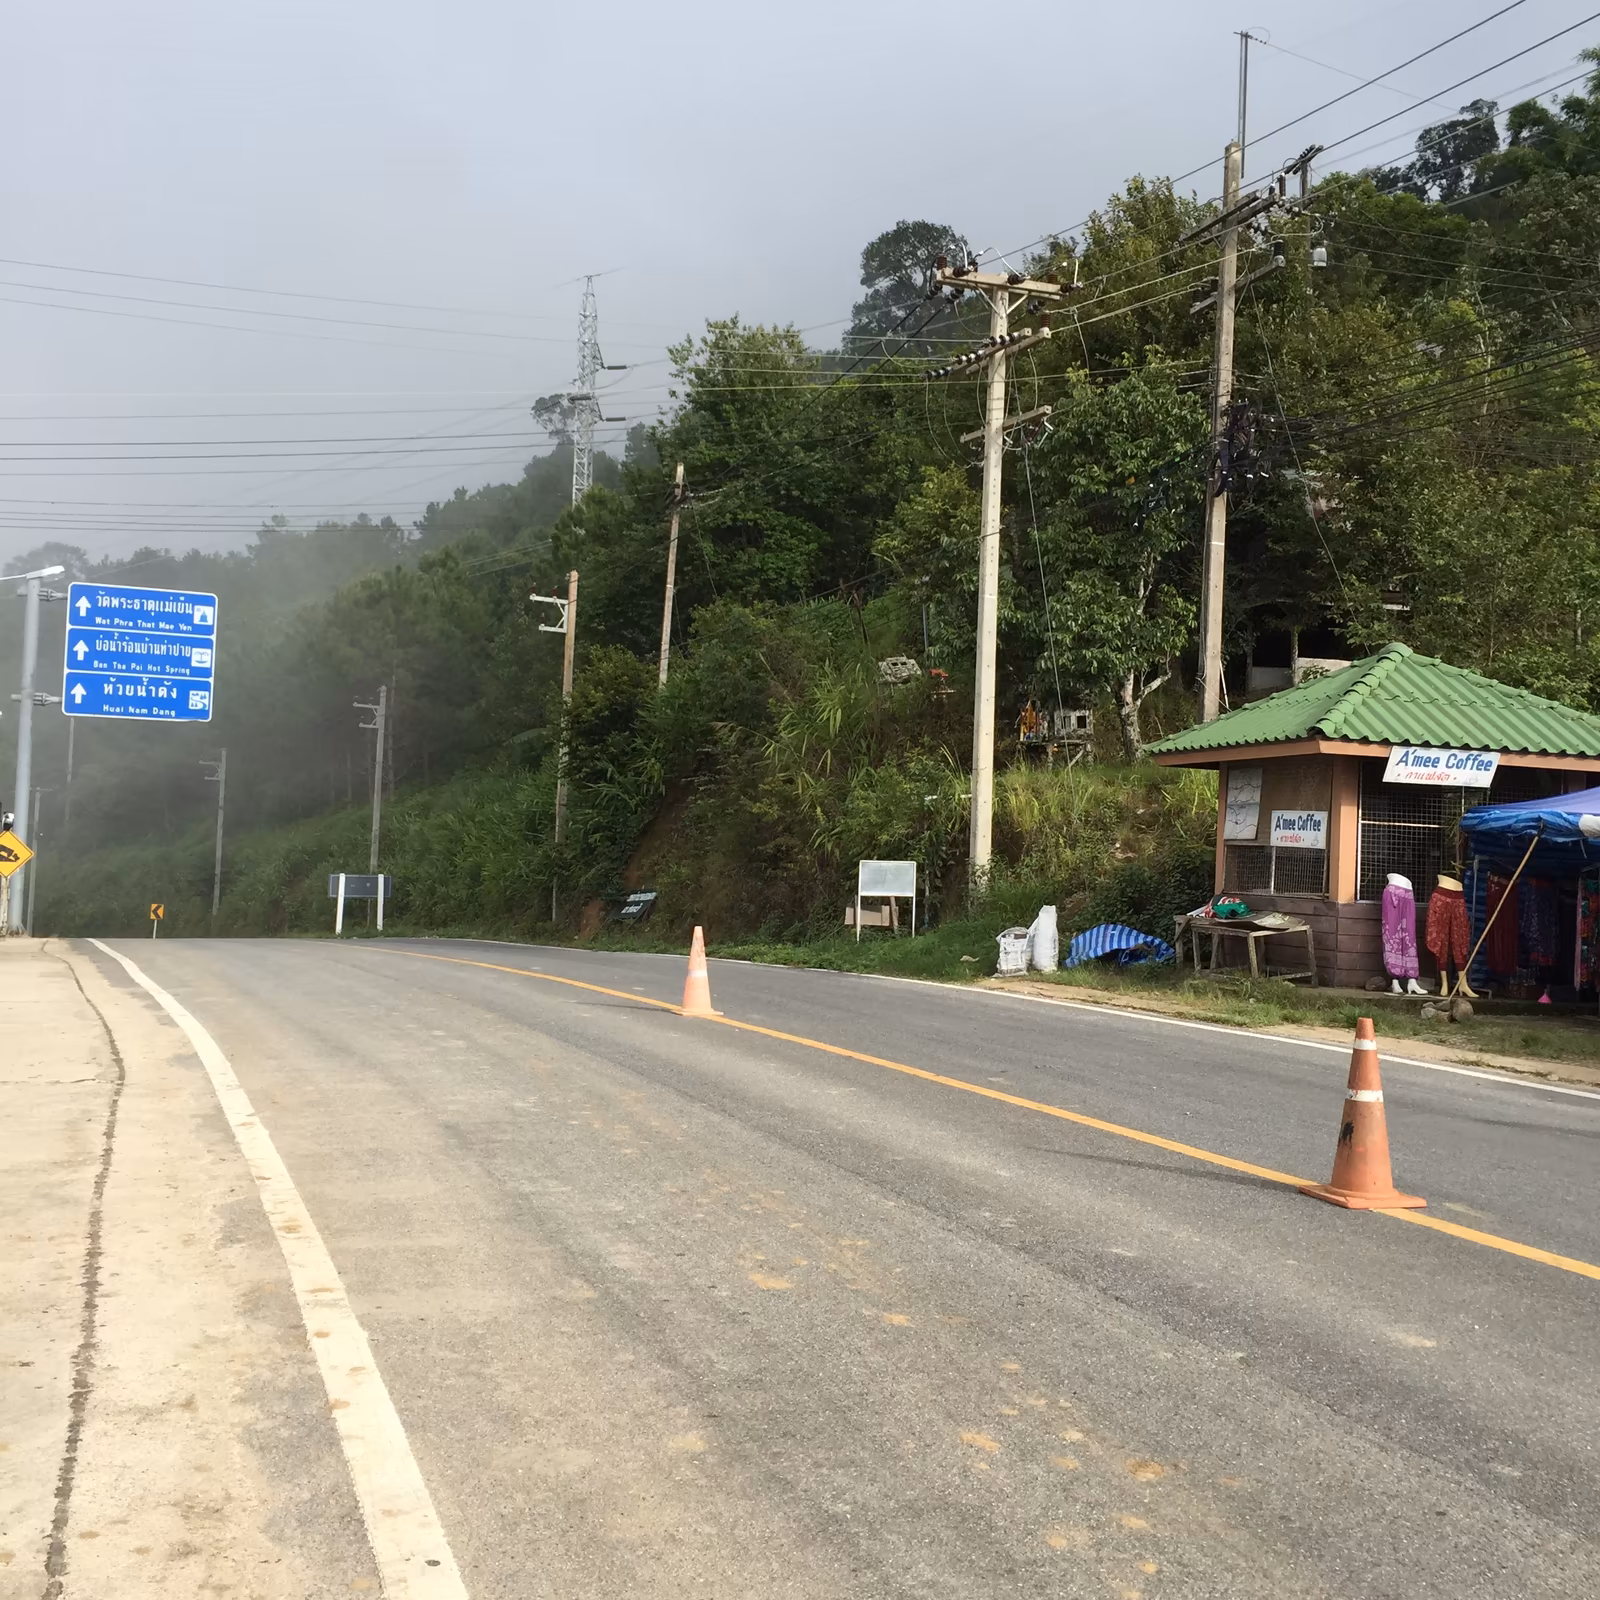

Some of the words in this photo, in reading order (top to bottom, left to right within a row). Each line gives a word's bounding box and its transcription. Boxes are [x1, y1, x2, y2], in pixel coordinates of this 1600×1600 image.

[95, 616, 111, 625] Wat
[114, 618, 133, 627] Phra
[138, 620, 155, 628] That
[113, 662, 126, 670] Tha
[131, 663, 142, 671] Pai
[148, 664, 160, 672] Hot
[166, 665, 190, 676] Spring
[103, 704, 124, 712] Huai
[152, 708, 176, 717] Dang
[1446, 753, 1493, 772] Coffee
[1298, 814, 1322, 832] Coffee
